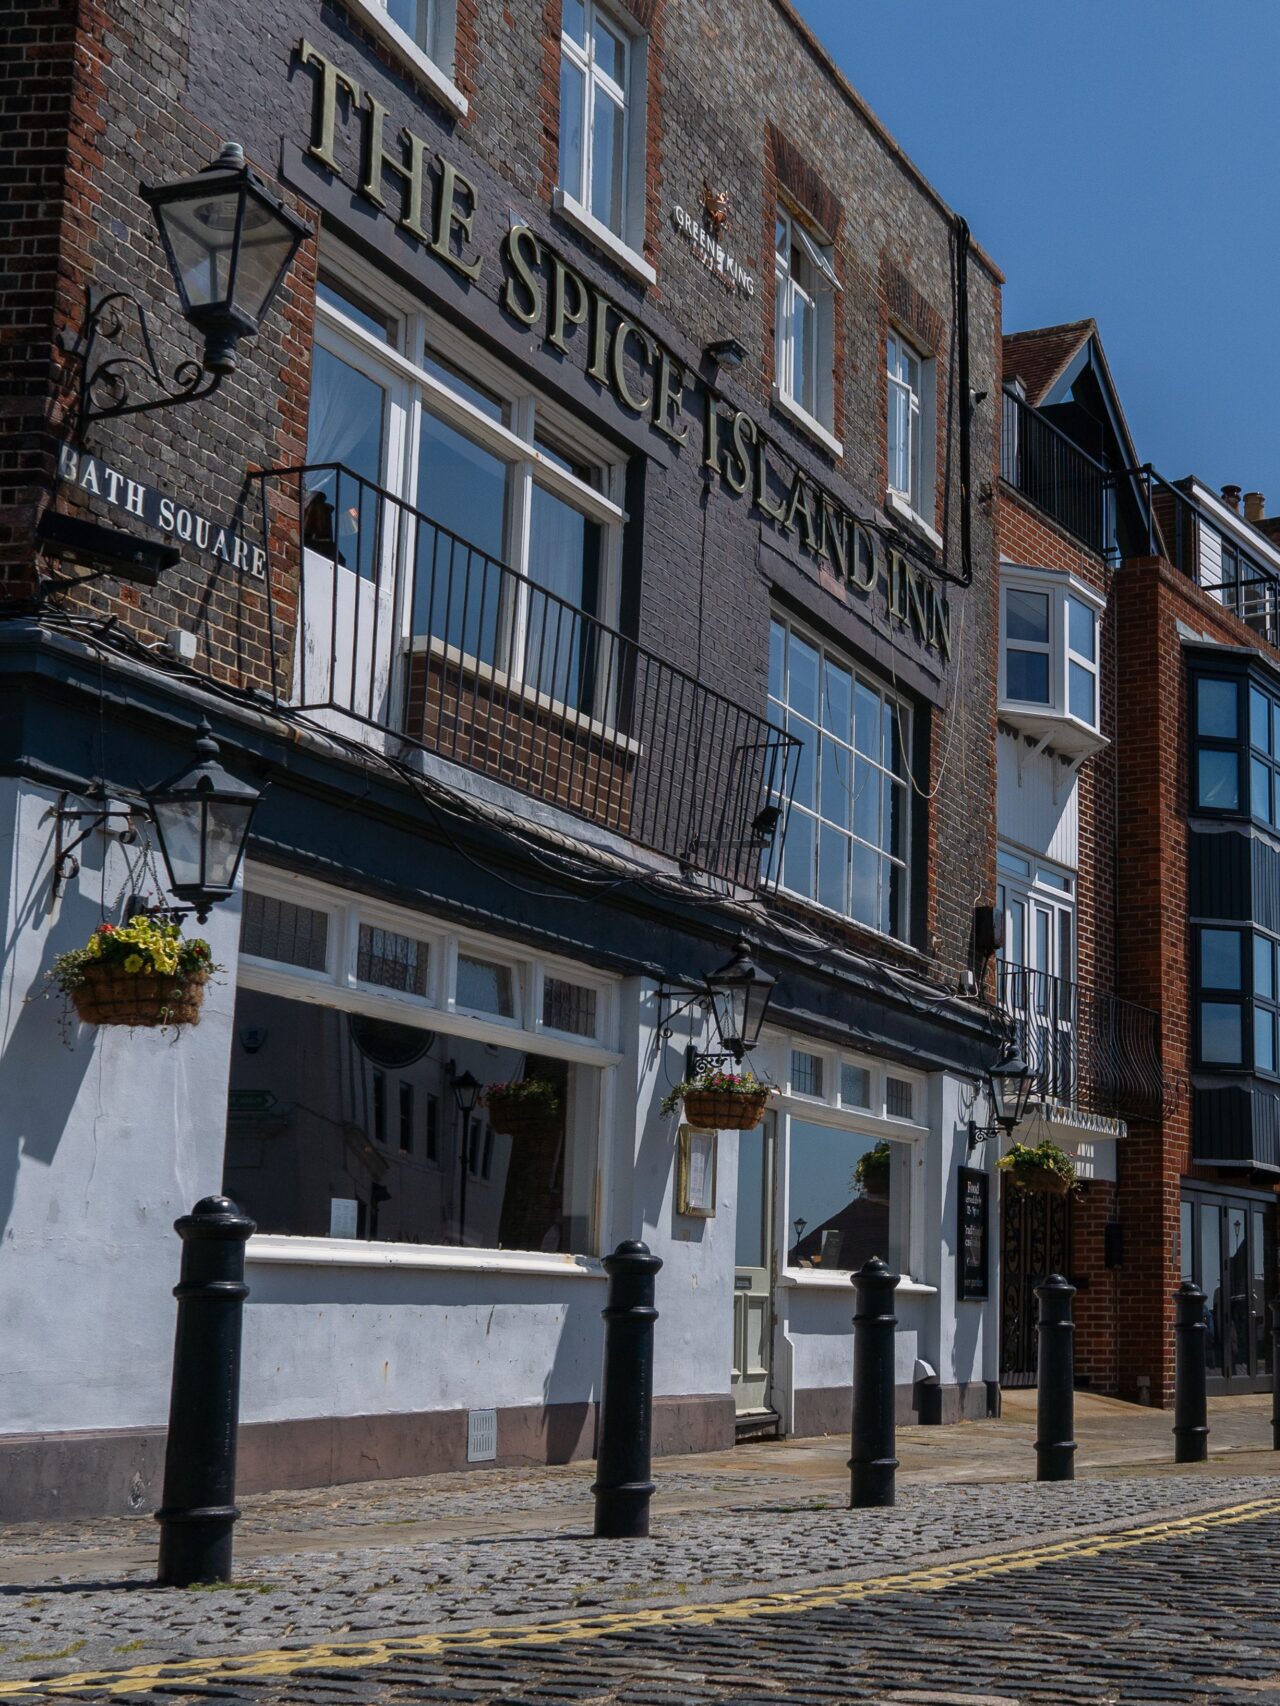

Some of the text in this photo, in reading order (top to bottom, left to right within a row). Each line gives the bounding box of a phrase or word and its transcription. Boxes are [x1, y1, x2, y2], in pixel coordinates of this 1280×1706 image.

[674, 205, 726, 262] GREENE
[726, 254, 755, 296] KING
[300, 38, 953, 662] THE SPICE ISLAND INN
[60, 444, 267, 580] BATH SQUARE
[967, 1181, 980, 1195] Food
